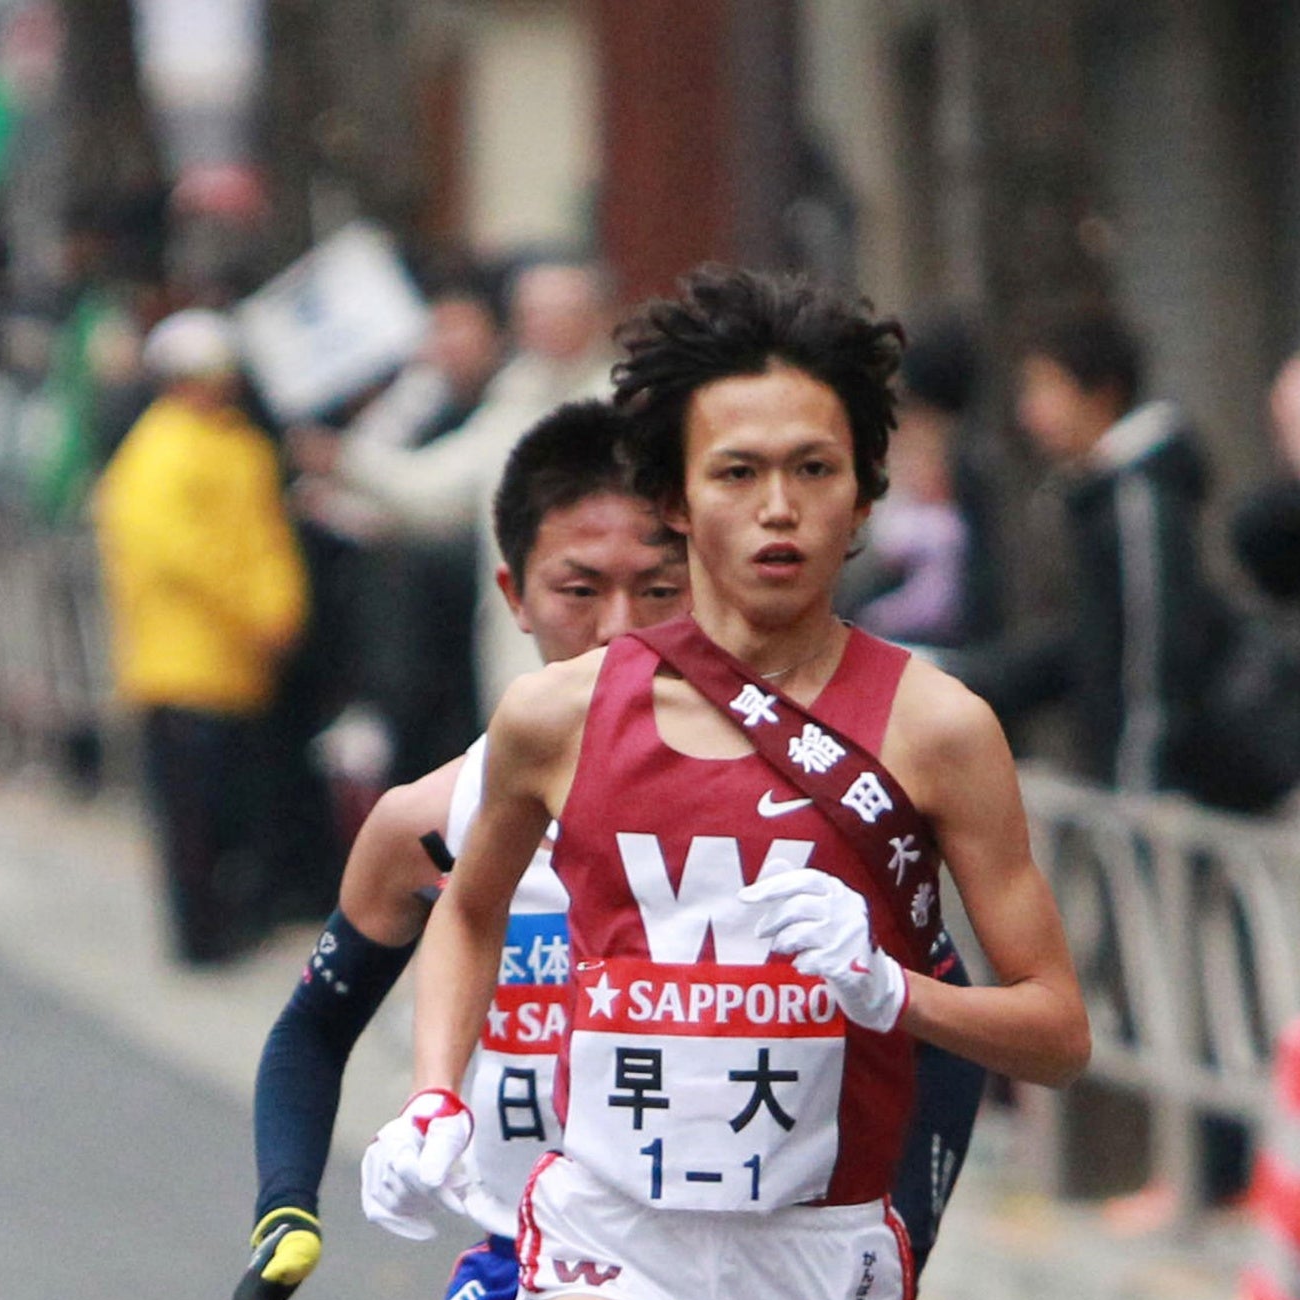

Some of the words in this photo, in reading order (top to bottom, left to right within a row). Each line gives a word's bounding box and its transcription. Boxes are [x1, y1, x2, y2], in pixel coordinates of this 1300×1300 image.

[615, 832, 815, 966] W
[627, 980, 838, 1025] SAPPORO
[499, 1067, 546, 1141] 日
